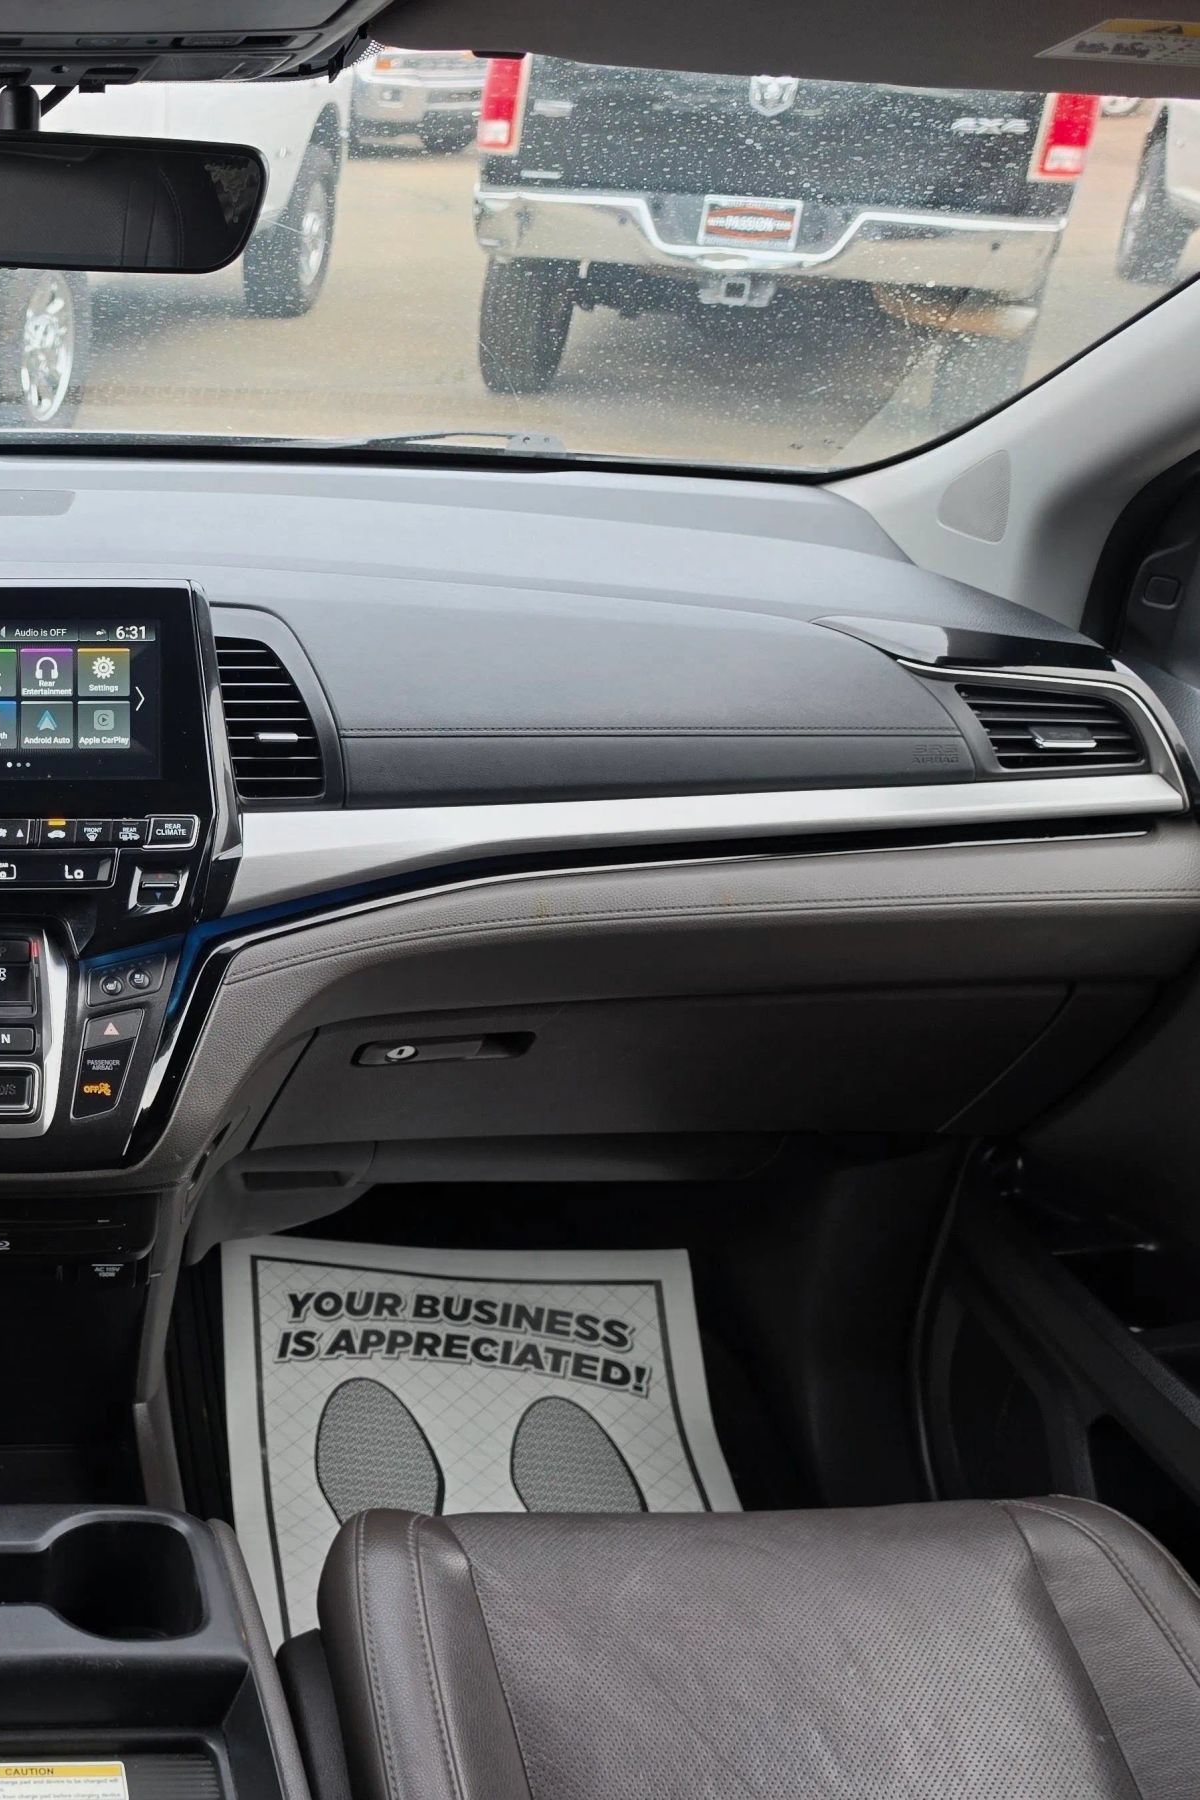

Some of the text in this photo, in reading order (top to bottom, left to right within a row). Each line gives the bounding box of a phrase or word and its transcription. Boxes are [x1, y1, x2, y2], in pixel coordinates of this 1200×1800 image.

[14, 627, 67, 637] Audio is OFF
[115, 625, 147, 640] 6:31
[38, 679, 56, 688] Rear
[21, 687, 73, 696] Entertainment
[88, 684, 119, 694] Settings
[23, 736, 71, 744] Android Auto
[79, 736, 129, 745] Apple CarPlay
[155, 828, 187, 836] CLIMATE
[65, 864, 84, 879] Lo
[1, 1033, 11, 1044] N
[83, 1085, 99, 1094] OFF
[288, 1290, 633, 1349] YOUR BUSINESS
[277, 1328, 647, 1392] IS APPRECIATED!
[4, 1767, 55, 1777] CAUTION
